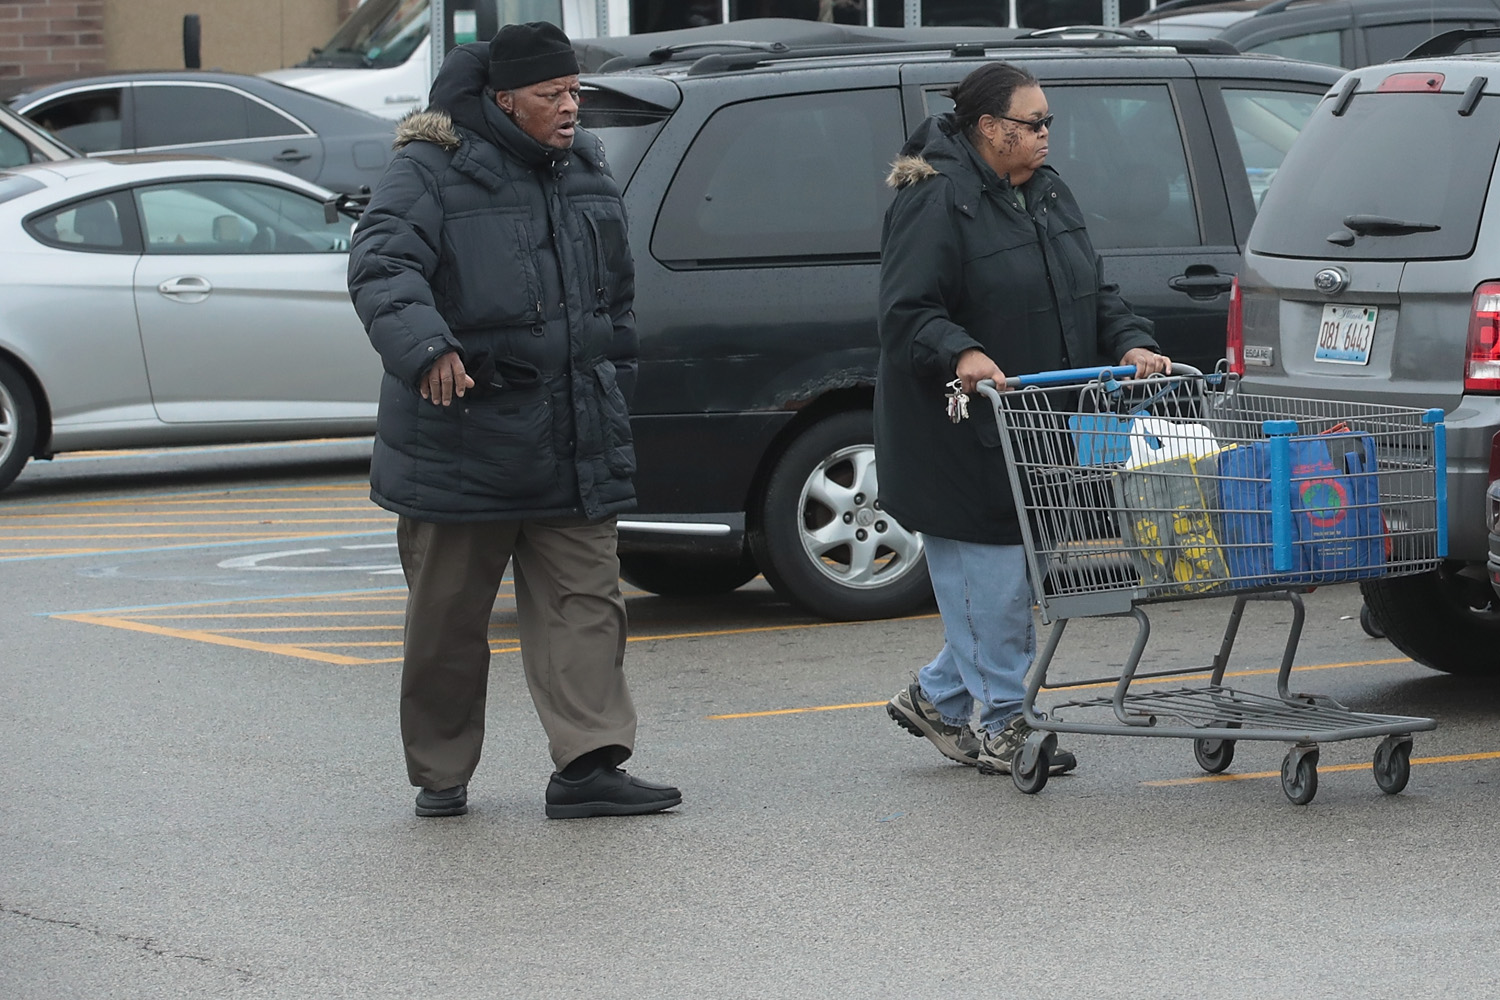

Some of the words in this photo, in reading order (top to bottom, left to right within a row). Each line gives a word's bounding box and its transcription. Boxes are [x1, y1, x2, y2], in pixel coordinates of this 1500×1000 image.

[1337, 308, 1364, 321] Illinois
[1319, 321, 1341, 350] Q81
[1343, 323, 1371, 353] 6443
